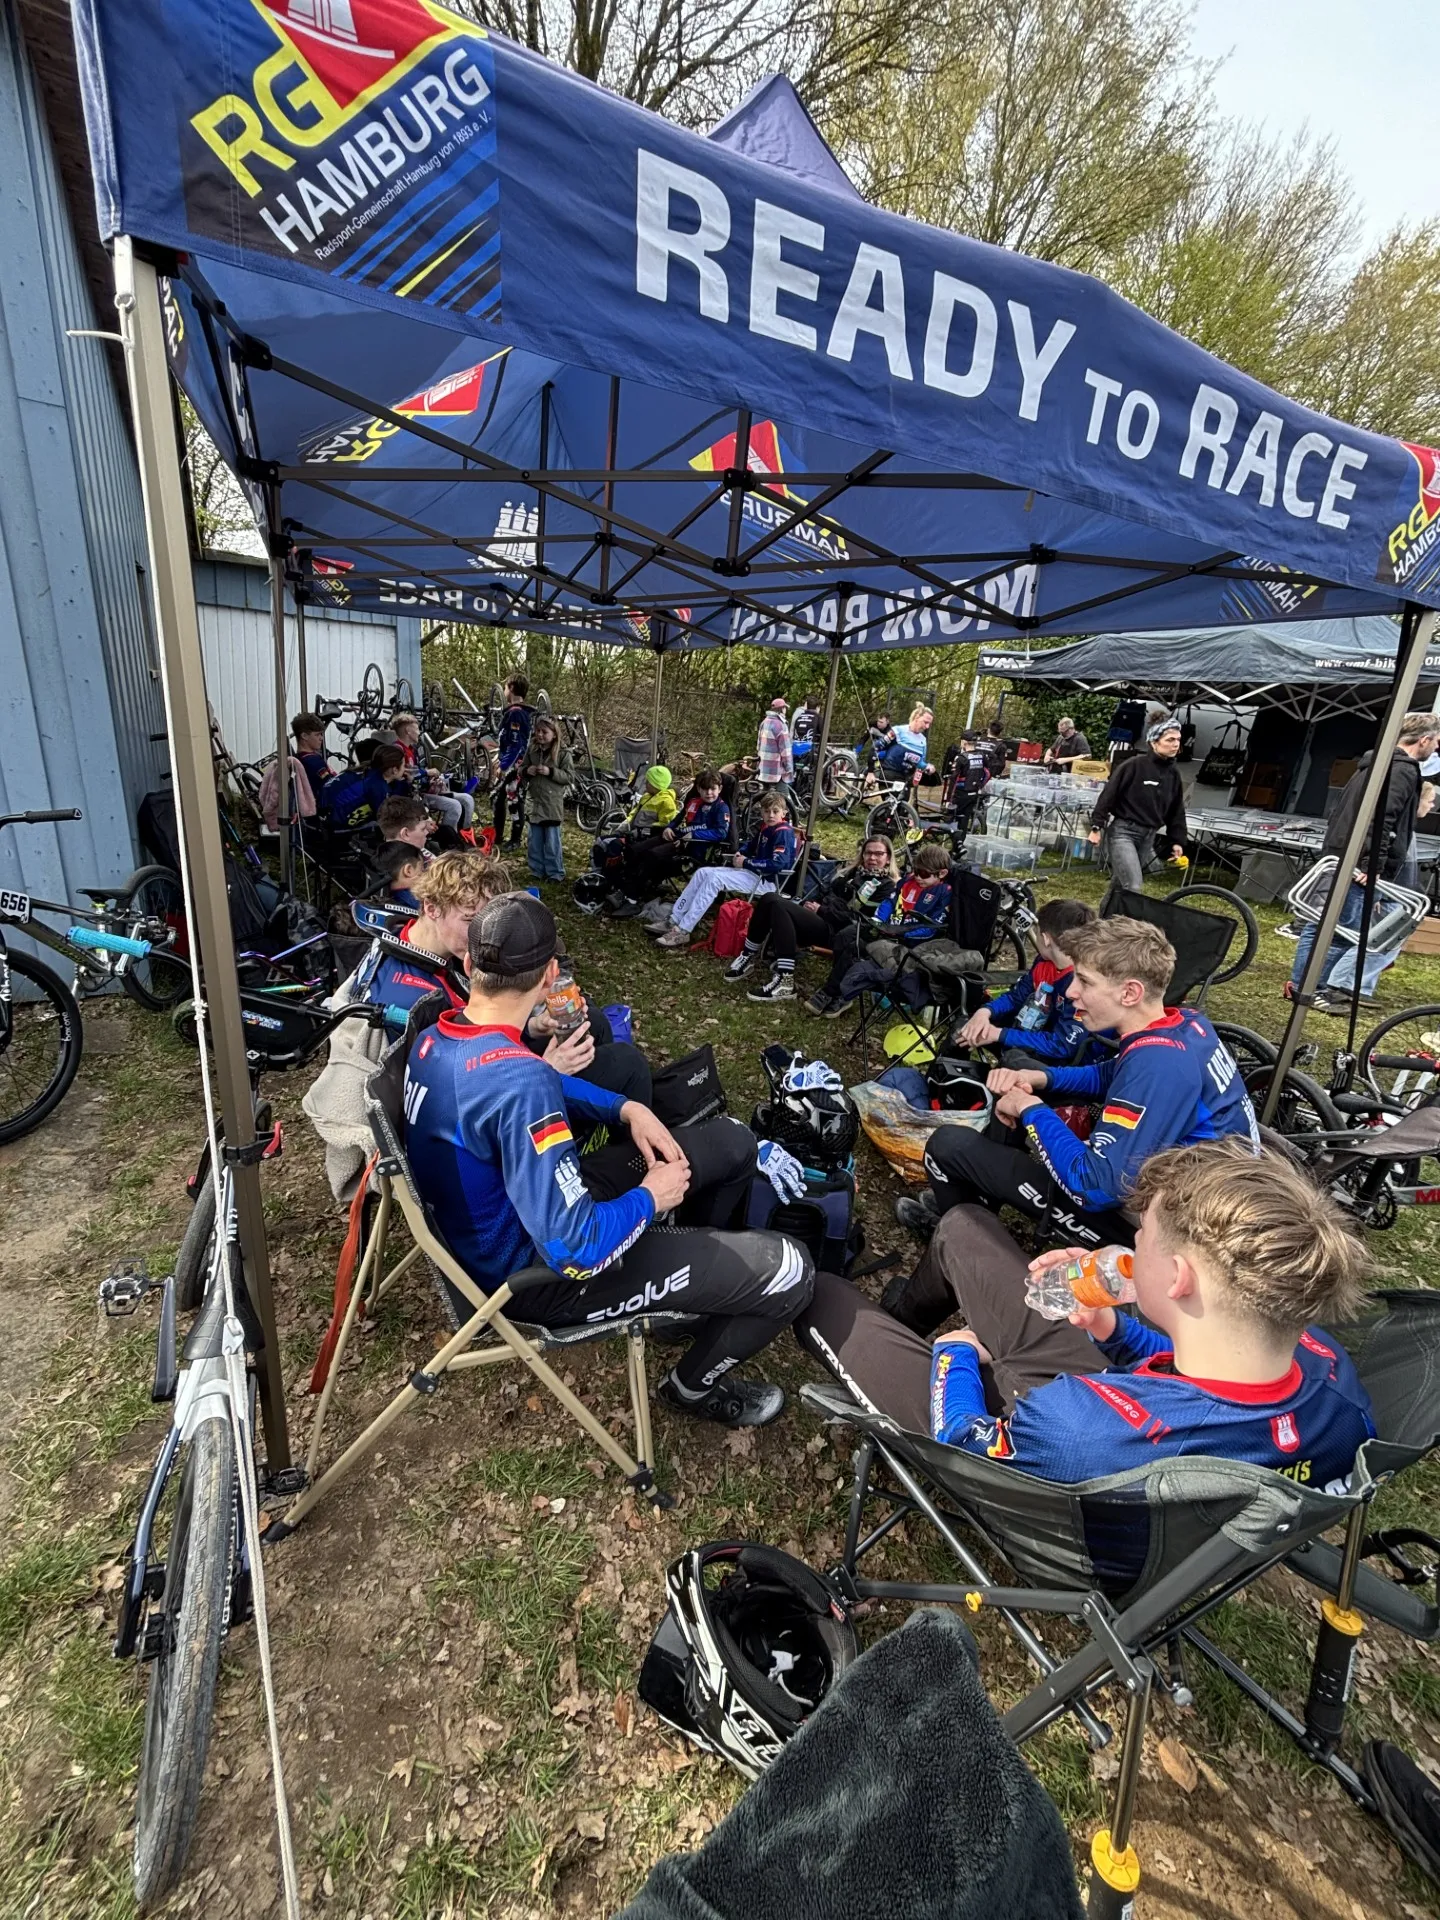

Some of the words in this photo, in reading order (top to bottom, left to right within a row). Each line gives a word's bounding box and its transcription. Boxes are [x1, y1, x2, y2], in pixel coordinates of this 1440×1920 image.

[190, 47, 345, 198] RG
[259, 49, 491, 253] HAMBURG
[314, 180, 407, 260] Radsport-Gemeinschaft
[404, 154, 442, 187] Hamburg
[438, 142, 455, 159] von
[453, 125, 473, 146] 1893
[636, 148, 1077, 422] READY
[1084, 368, 1160, 460] TO
[1179, 384, 1368, 530] RACE
[1388, 501, 1428, 563] RG
[0, 892, 28, 912] 656
[546, 995, 569, 1005] hella
